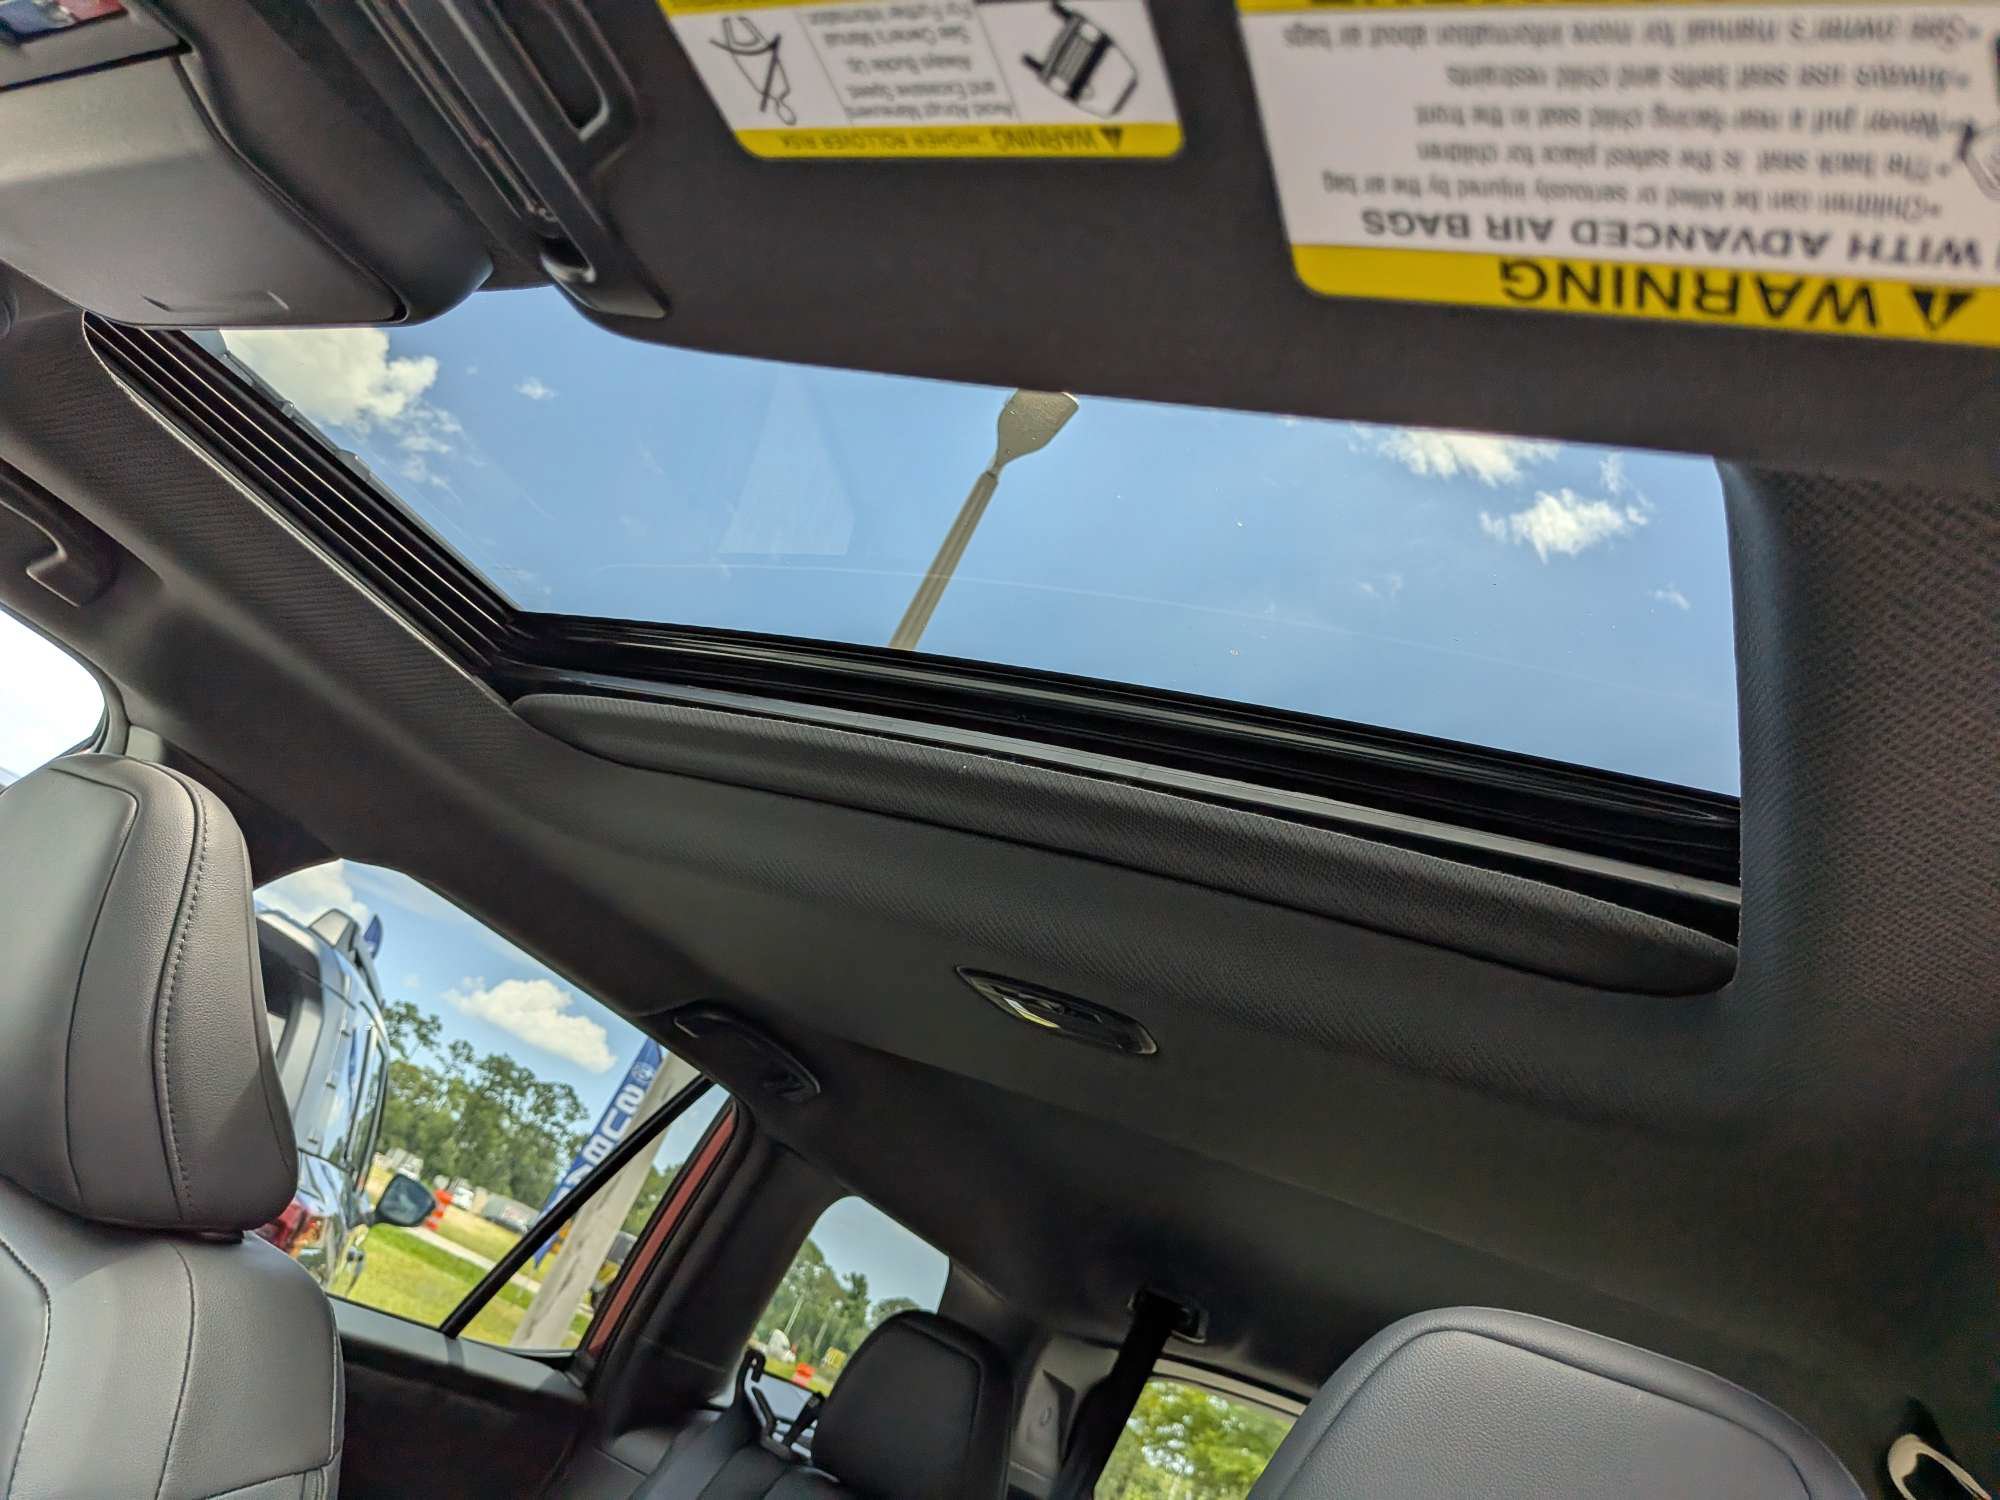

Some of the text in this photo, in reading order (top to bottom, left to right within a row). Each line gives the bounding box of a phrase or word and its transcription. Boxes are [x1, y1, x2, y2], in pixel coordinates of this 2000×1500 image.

[825, 33, 874, 49] Manual
[1282, 22, 1333, 50] bags
[1368, 23, 1428, 50] about
[1438, 23, 1564, 47] information
[1570, 21, 1633, 47] more
[1643, 20, 1676, 49] for
[1685, 17, 1780, 46] manual
[1446, 65, 1548, 89] restraints
[1618, 65, 1662, 91] and
[1738, 64, 1790, 89] seat
[1415, 106, 1465, 128] front
[1472, 106, 1505, 129] the
[1539, 107, 1582, 129] seat
[1811, 107, 1856, 137] put
[1866, 110, 1939, 140] Never
[821, 134, 907, 150] ROLLOVER
[991, 128, 1097, 151] WARNING
[1417, 143, 1498, 165] children
[1507, 145, 1535, 168] for
[1542, 144, 1599, 168] place
[1604, 146, 1670, 172] safest
[1679, 150, 1713, 173] the
[1757, 152, 1807, 176] seat
[1322, 169, 1357, 194] bag
[1364, 174, 1385, 193] air
[1391, 175, 1421, 197] the
[1429, 173, 1450, 197] by
[1457, 176, 1525, 202] injured
[1535, 178, 1628, 205] seriously
[1638, 186, 1656, 206] or
[1667, 186, 1725, 211] killed
[1733, 191, 1760, 214] be
[1769, 191, 1811, 216] can
[1360, 209, 1471, 240] BAGS
[1484, 216, 1555, 244] AIR
[1569, 216, 1832, 260] ADVANCED
[1846, 234, 1982, 272] WITH
[1498, 259, 1879, 330] WARNING
